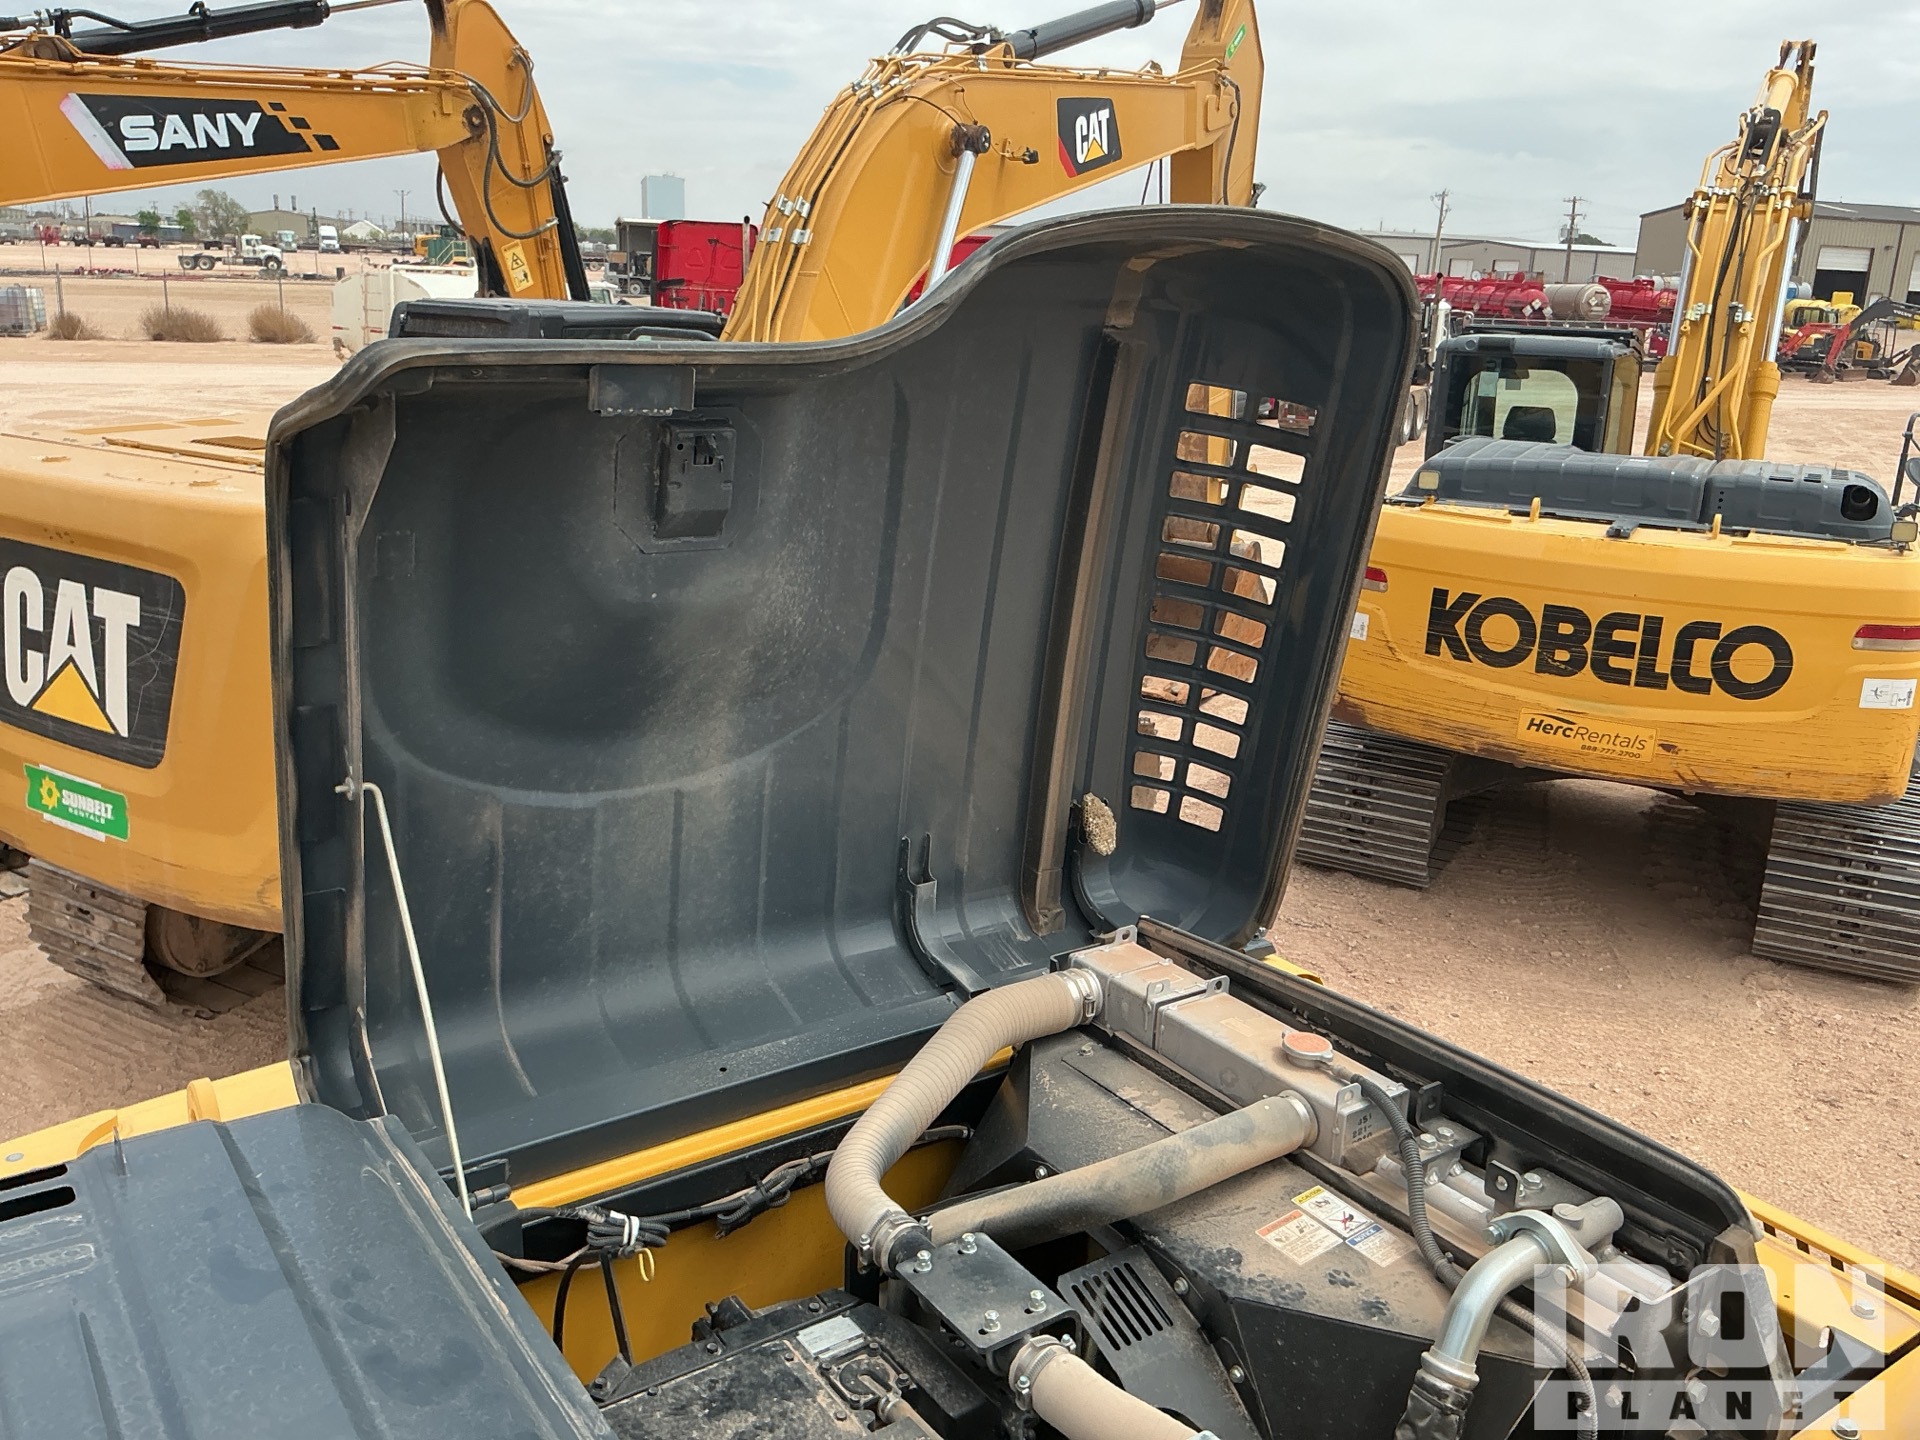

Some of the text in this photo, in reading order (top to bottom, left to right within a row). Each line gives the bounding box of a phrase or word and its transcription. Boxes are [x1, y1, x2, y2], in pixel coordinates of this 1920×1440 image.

[120, 112, 262, 152] SANY
[1075, 107, 1110, 164] CAT
[3, 565, 141, 738] CAT
[1424, 586, 1794, 701] KOBELCO
[1580, 744, 1641, 759] 888-777-2700
[61, 788, 114, 819] SUNBELT
[68, 806, 106, 825] RENTALS
[1354, 1228, 1377, 1242] NOTICE
